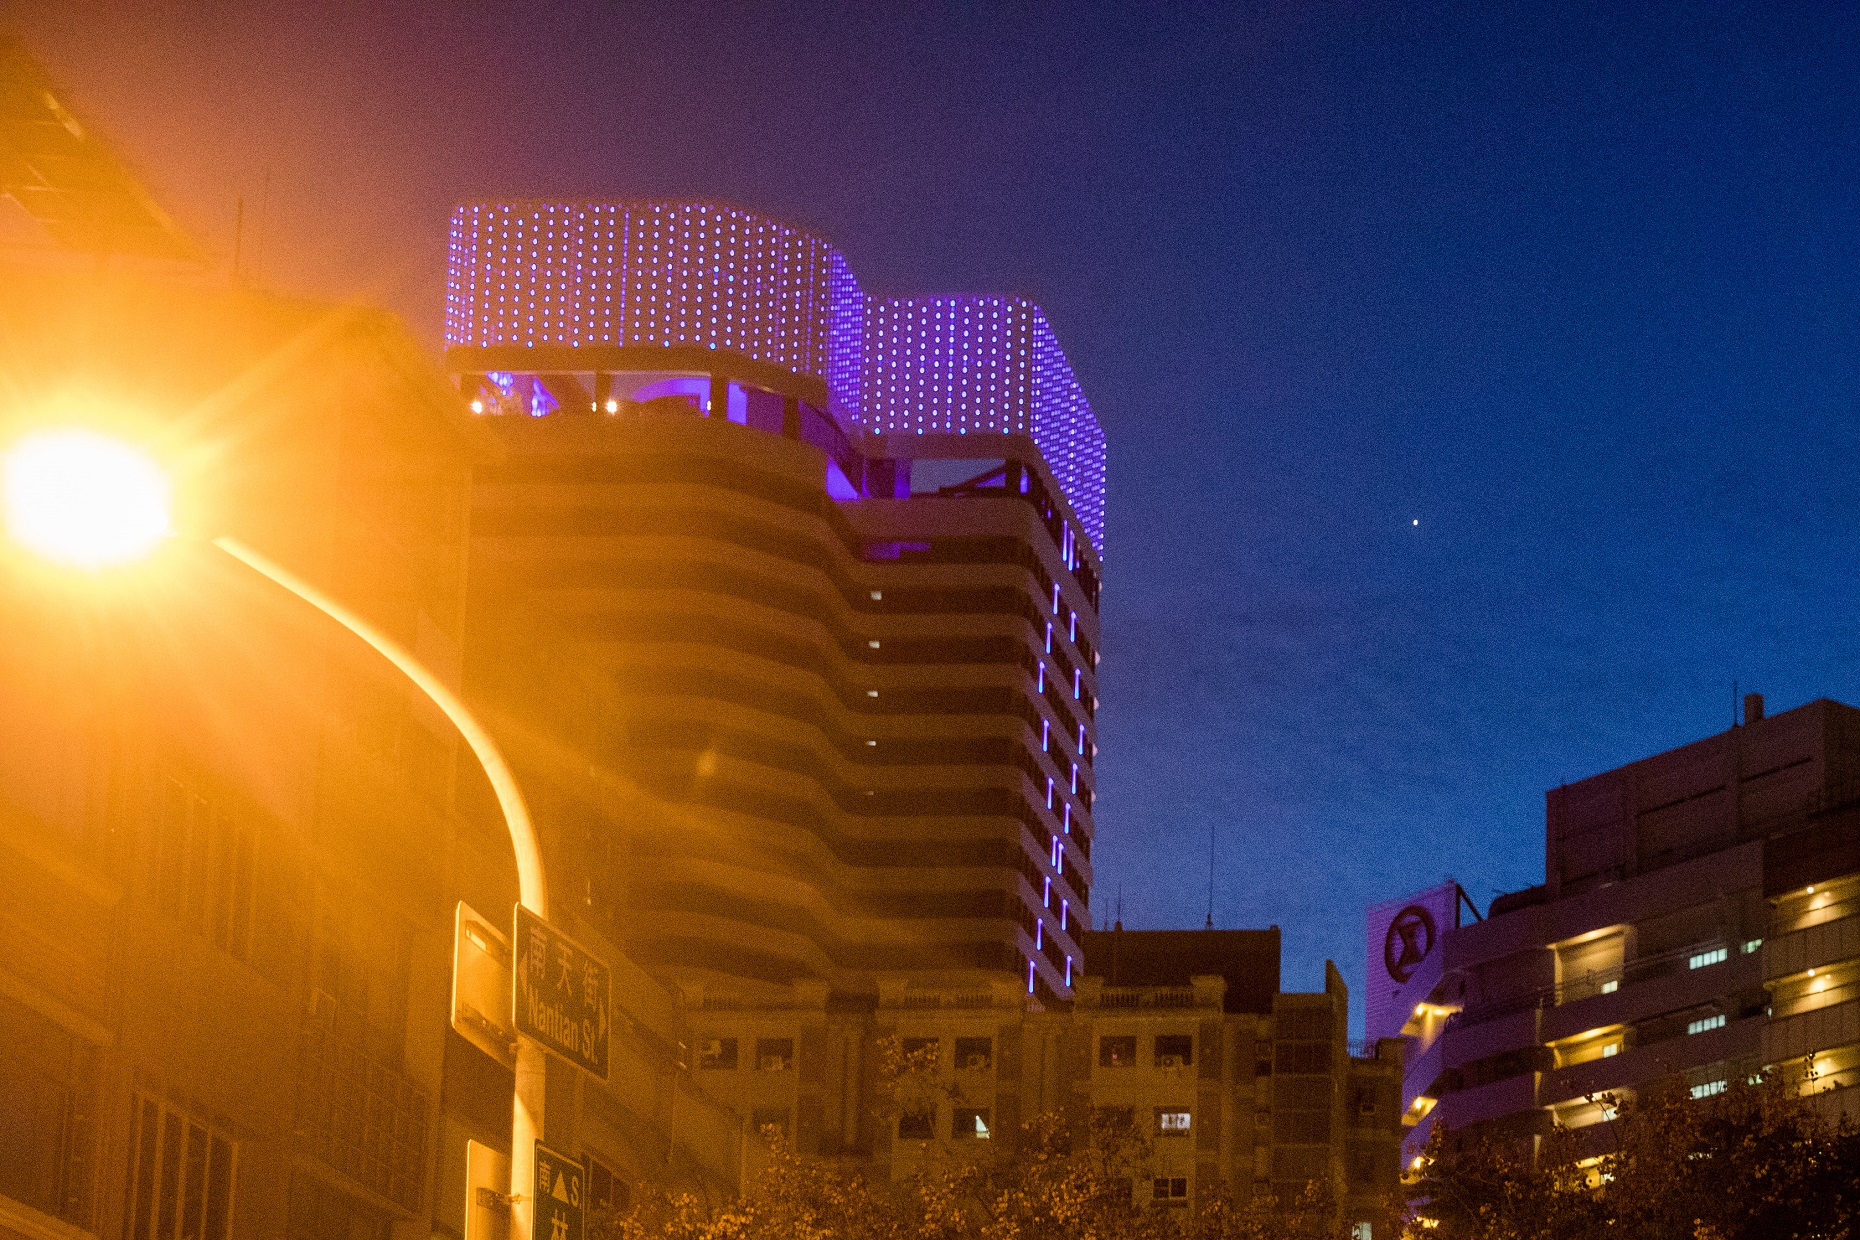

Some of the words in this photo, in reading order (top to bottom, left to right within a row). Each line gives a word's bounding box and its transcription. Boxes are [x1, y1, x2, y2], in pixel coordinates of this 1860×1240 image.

[529, 925, 599, 1014] 南天街
[528, 983, 579, 1052] Nantian
[539, 1160, 551, 1194] 南
